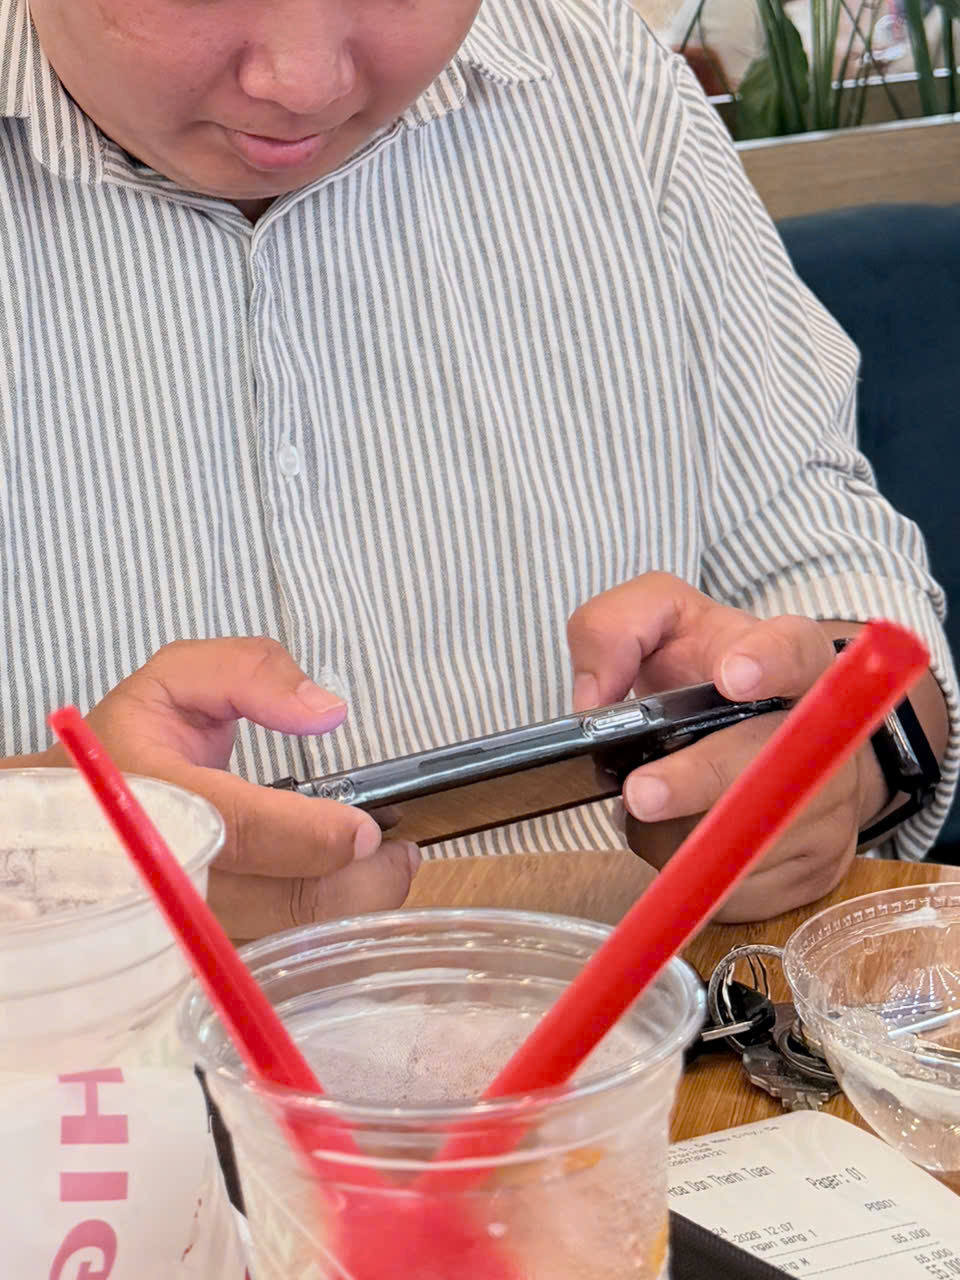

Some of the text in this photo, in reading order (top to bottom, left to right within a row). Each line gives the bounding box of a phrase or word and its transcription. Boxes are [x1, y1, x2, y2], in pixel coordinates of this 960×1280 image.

[684, 1180, 713, 1192] Don
[707, 1171, 746, 1186] Thanh
[805, 1167, 868, 1190] Pager: 01
[763, 1221, 795, 1236] 12:07
[891, 1228, 931, 1244] 55.000
[914, 1248, 953, 1264] 55.000
